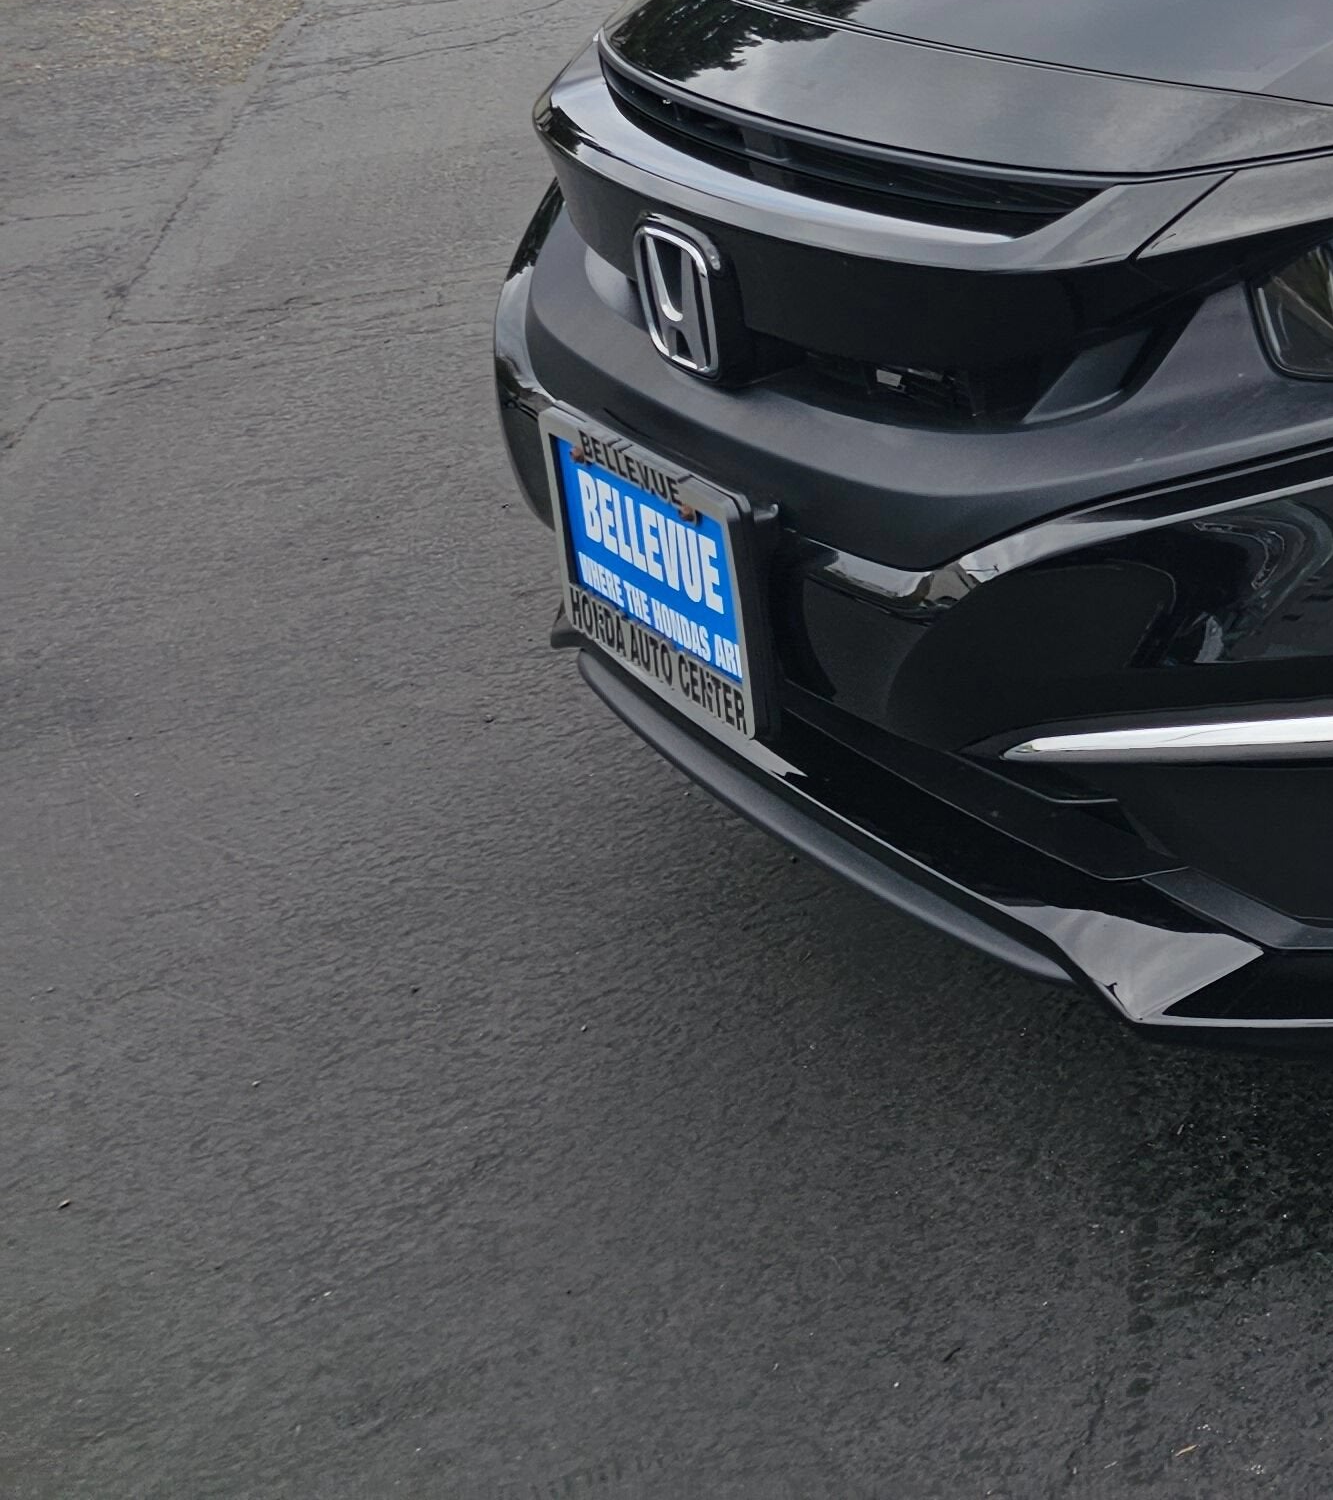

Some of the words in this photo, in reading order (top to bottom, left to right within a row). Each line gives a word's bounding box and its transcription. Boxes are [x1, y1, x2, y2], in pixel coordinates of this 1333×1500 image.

[578, 429, 683, 506] BELLEVUE
[577, 468, 725, 615] BELLEVUE
[569, 586, 627, 658] HONDA
[630, 622, 673, 687] AUTO
[678, 653, 748, 736] CENTER
[578, 551, 625, 608] WHERE
[623, 579, 651, 625] THE
[651, 597, 712, 662] HONDAS
